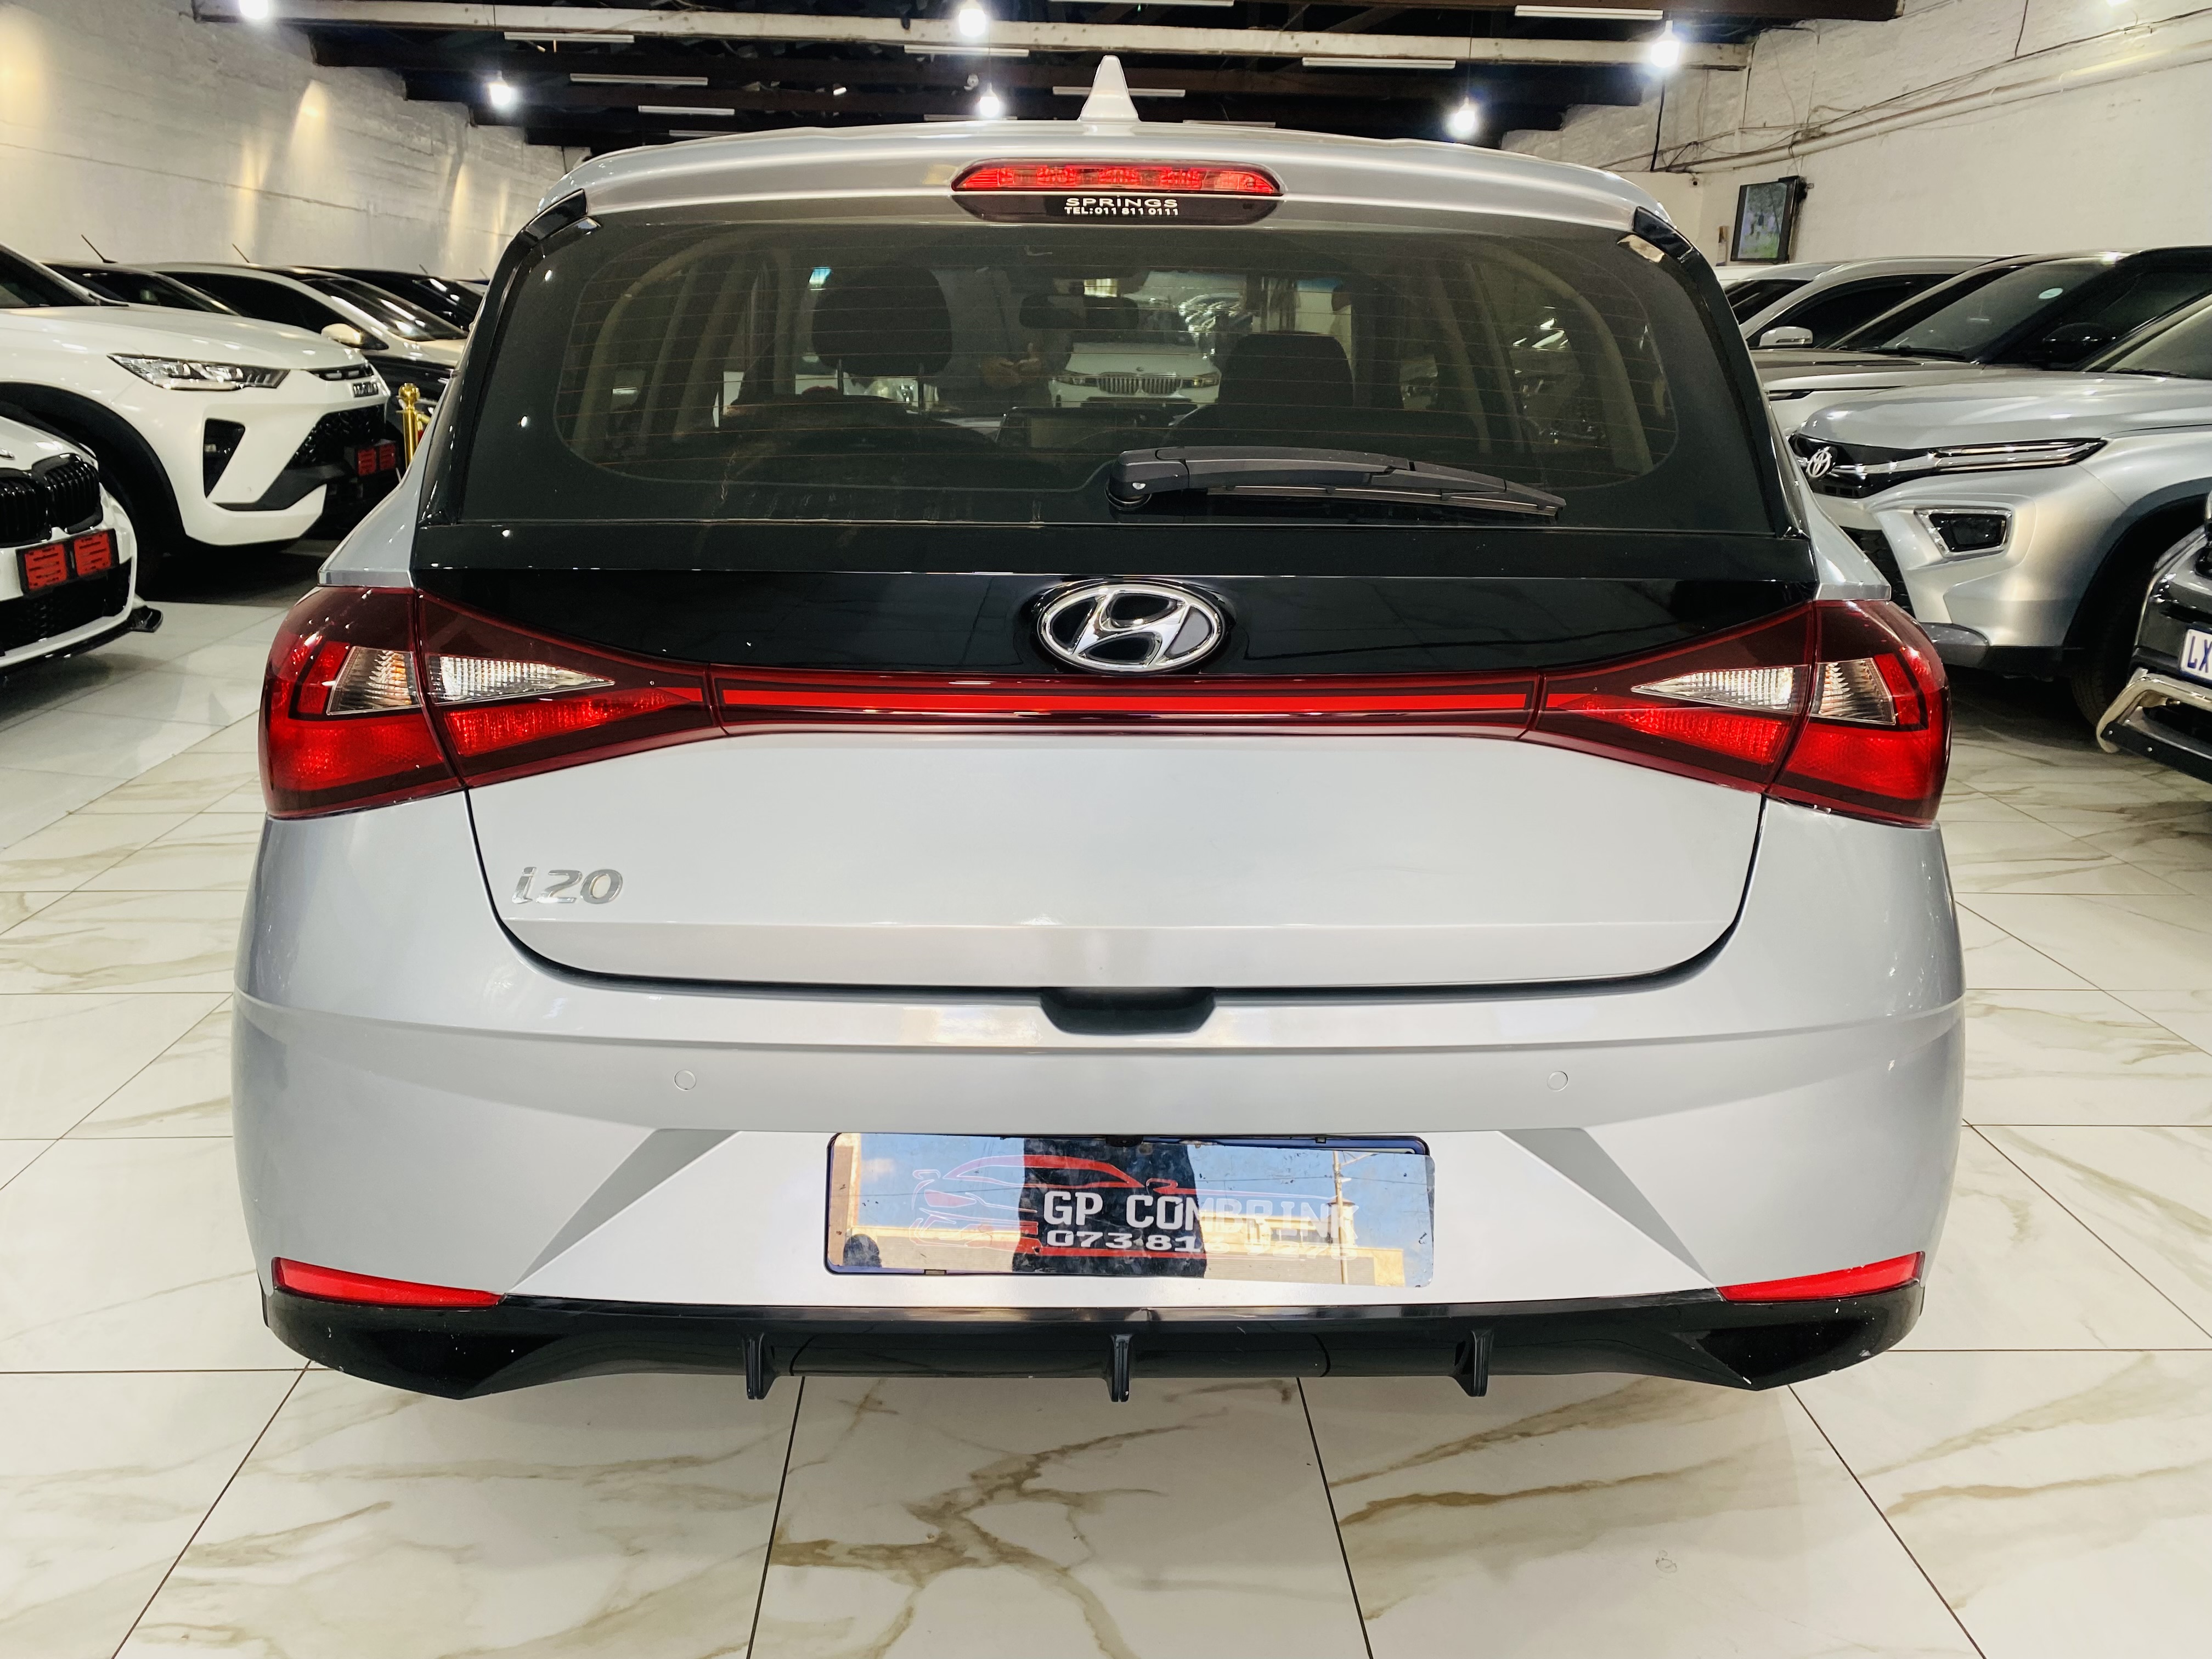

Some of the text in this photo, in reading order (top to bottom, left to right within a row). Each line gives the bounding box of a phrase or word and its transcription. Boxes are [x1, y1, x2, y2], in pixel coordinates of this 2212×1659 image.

[1065, 197, 1178, 208] SPRINGS
[1121, 207, 1144, 215] 811
[1148, 207, 1179, 216] 0111
[511, 866, 623, 905] i20
[1043, 1190, 1103, 1226] GP
[1047, 1229, 1133, 1249] 073
